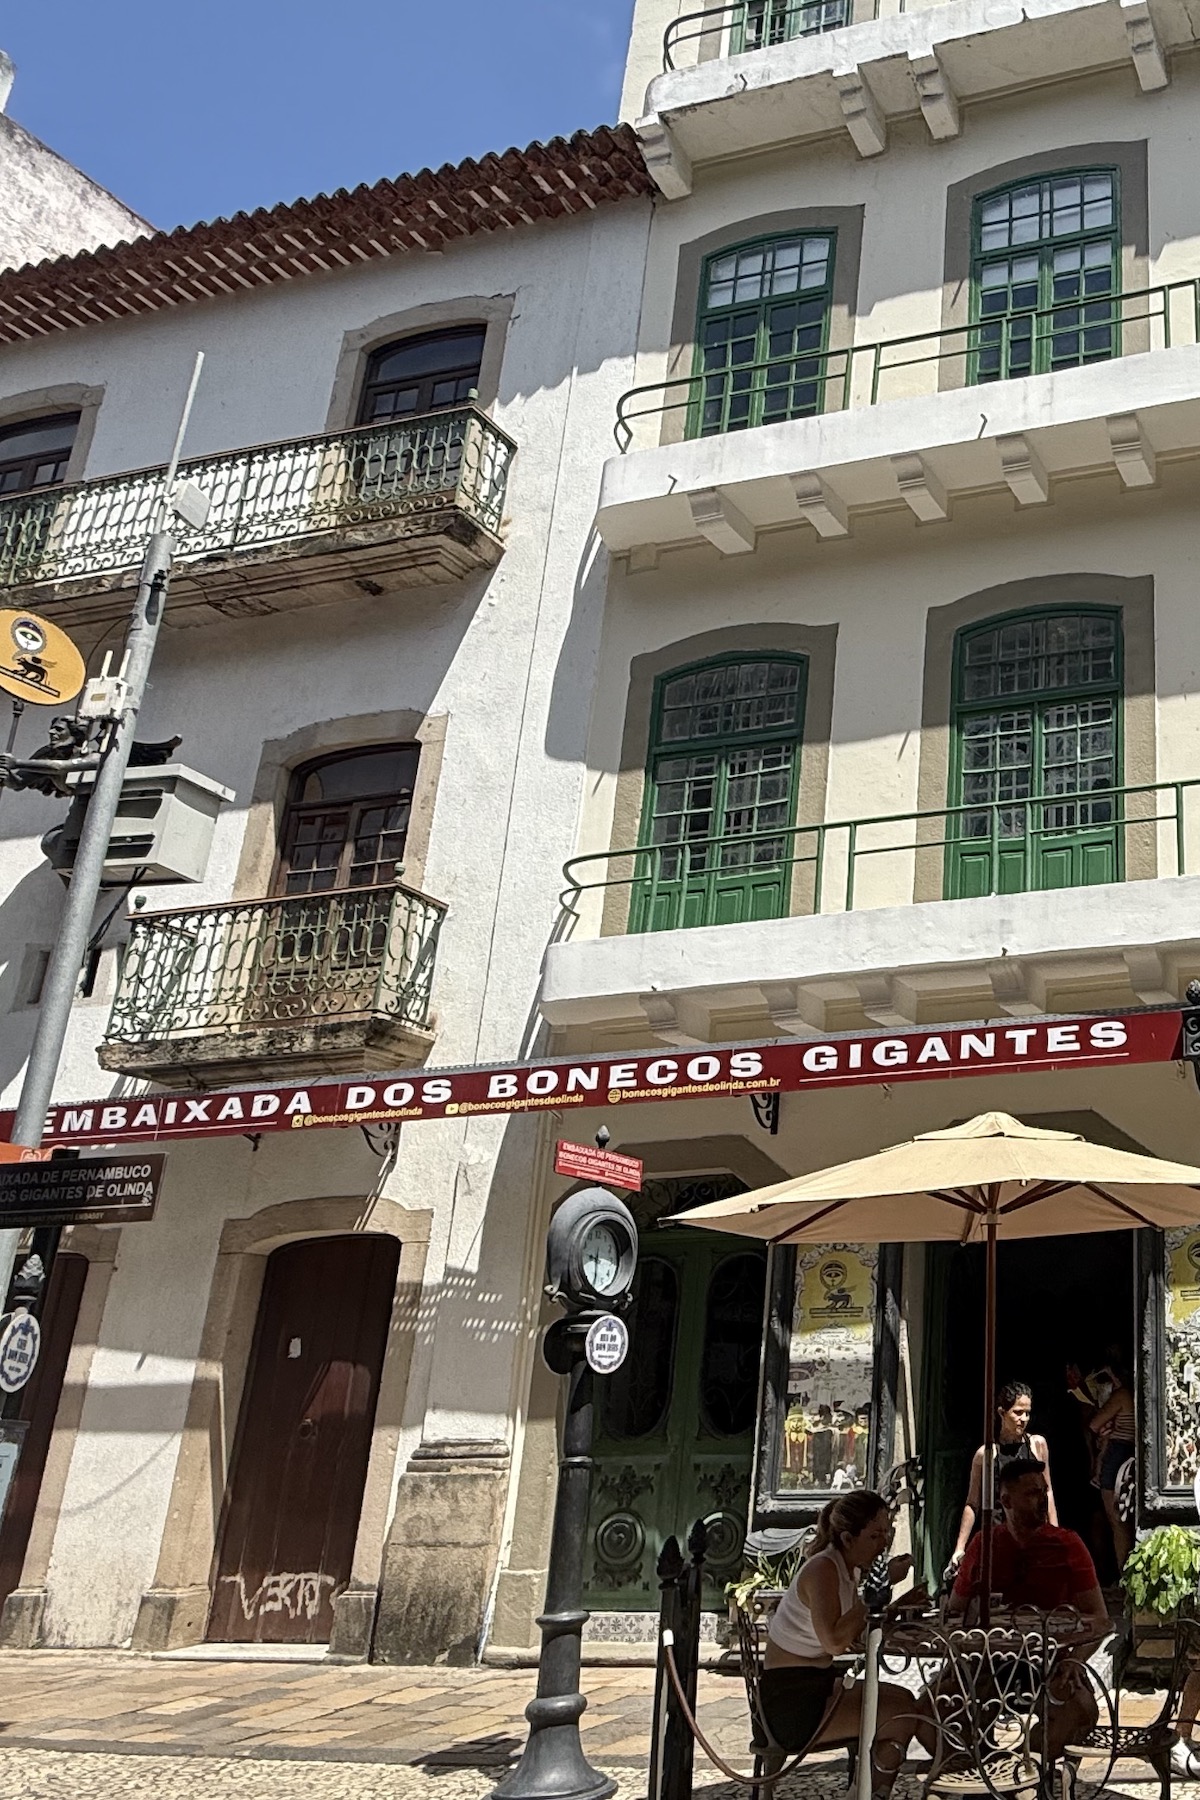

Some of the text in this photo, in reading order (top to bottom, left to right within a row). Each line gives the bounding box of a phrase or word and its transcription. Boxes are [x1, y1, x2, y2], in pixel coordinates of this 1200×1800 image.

[42, 1020, 1130, 1134] EMBAIXADA DOS BONECOS GIGANTES
[622, 1076, 781, 1099] bonecosgigantesdeolinda.com.br
[304, 1106, 423, 1126] @bonecosgigantesdeolinda
[0, 1164, 152, 1187] IXADA DE PERNAMBUCO
[20, 1185, 83, 1202] GIGANTES
[86, 1184, 105, 1200] DE
[106, 1181, 154, 1198] OLINDA
